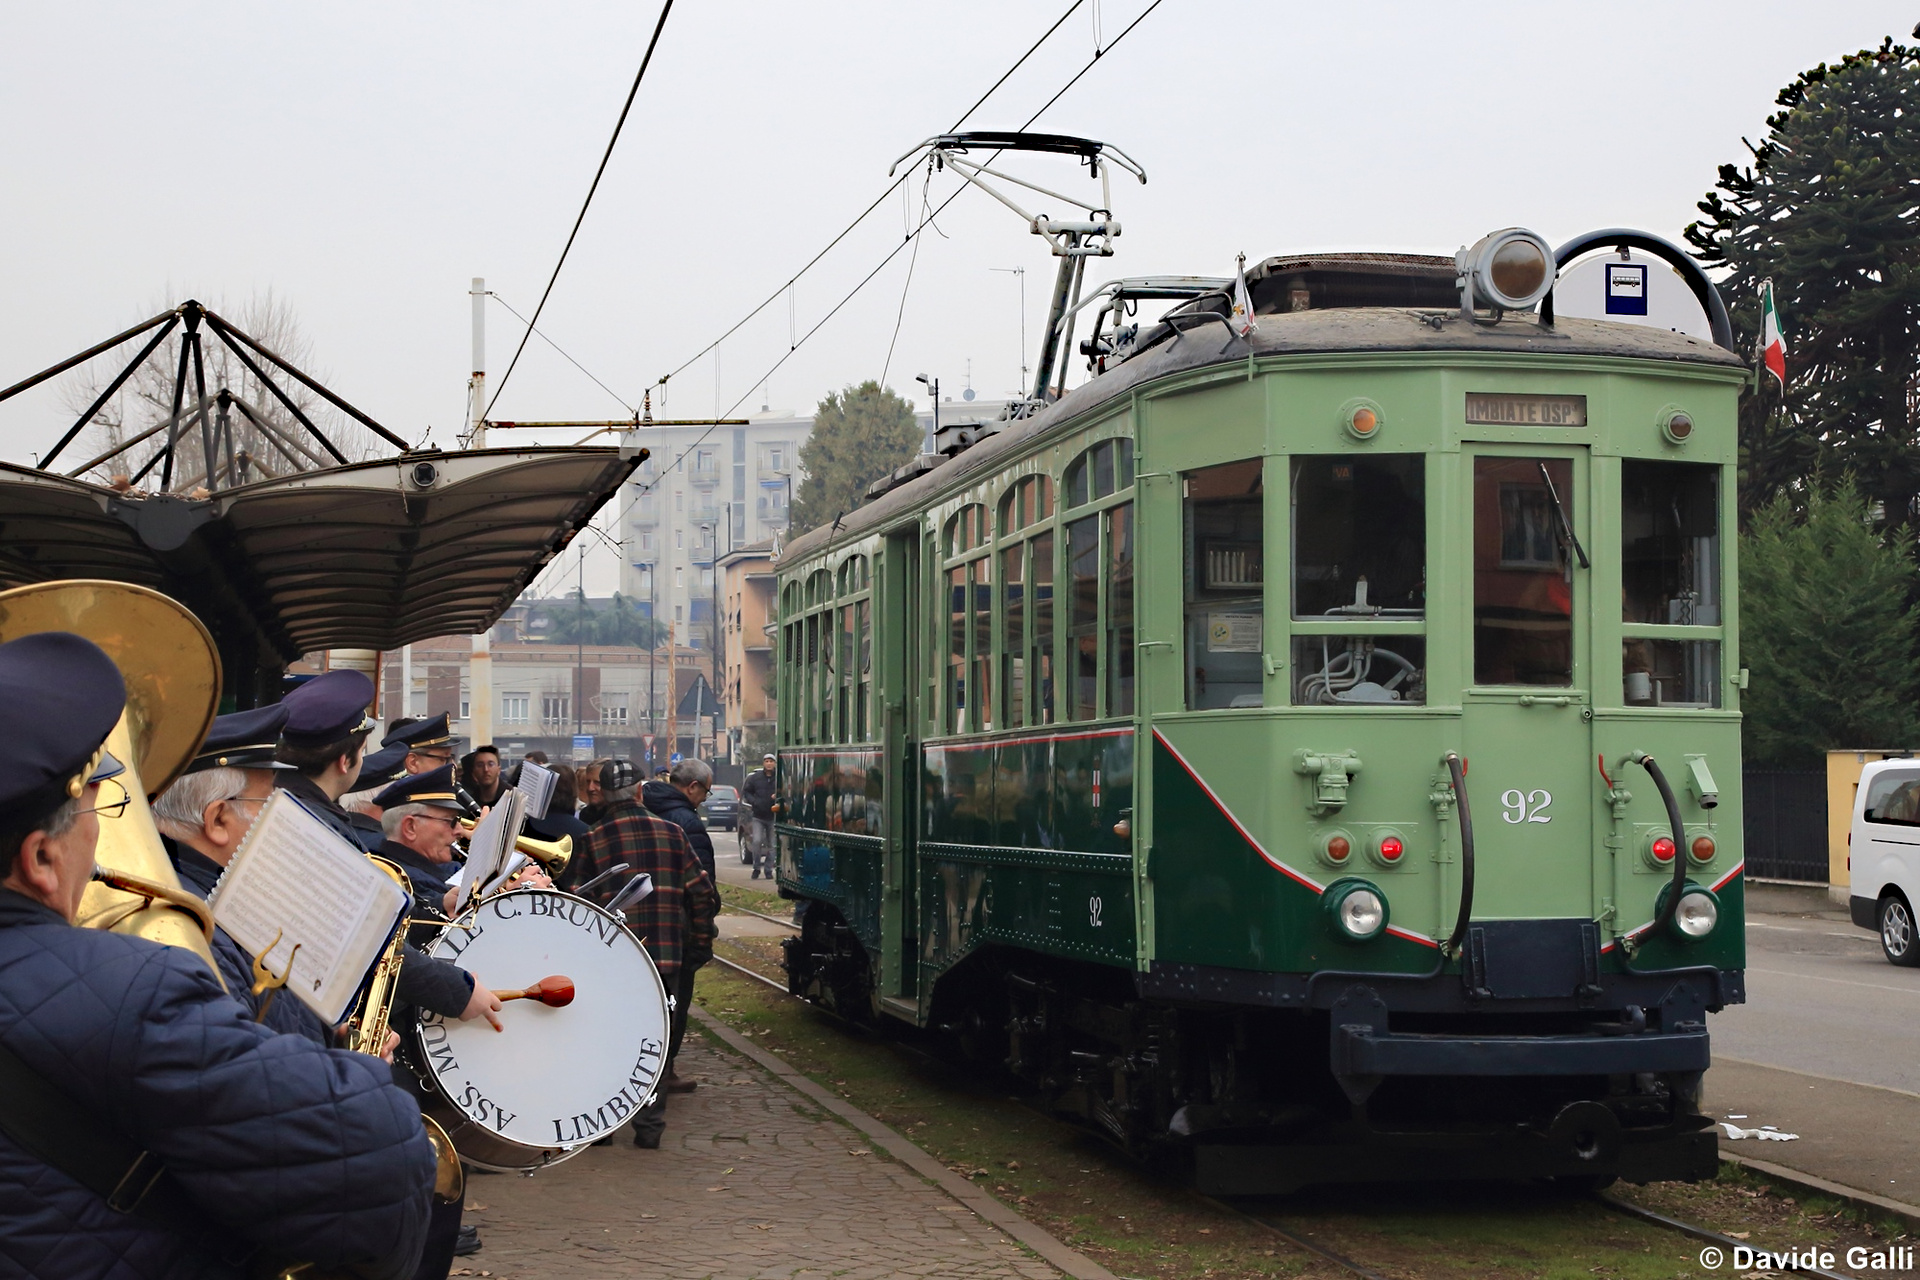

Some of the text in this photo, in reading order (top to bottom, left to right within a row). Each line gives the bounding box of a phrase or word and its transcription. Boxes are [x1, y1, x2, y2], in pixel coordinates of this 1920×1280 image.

[1466, 399, 1537, 422] IMBIATE
[1500, 788, 1552, 824] 92
[1089, 896, 1103, 927] 92
[456, 1080, 517, 1132] ASS.
[494, 897, 522, 920] C.
[529, 894, 624, 949] BRUNI
[552, 1037, 664, 1143] LIMBIATE
